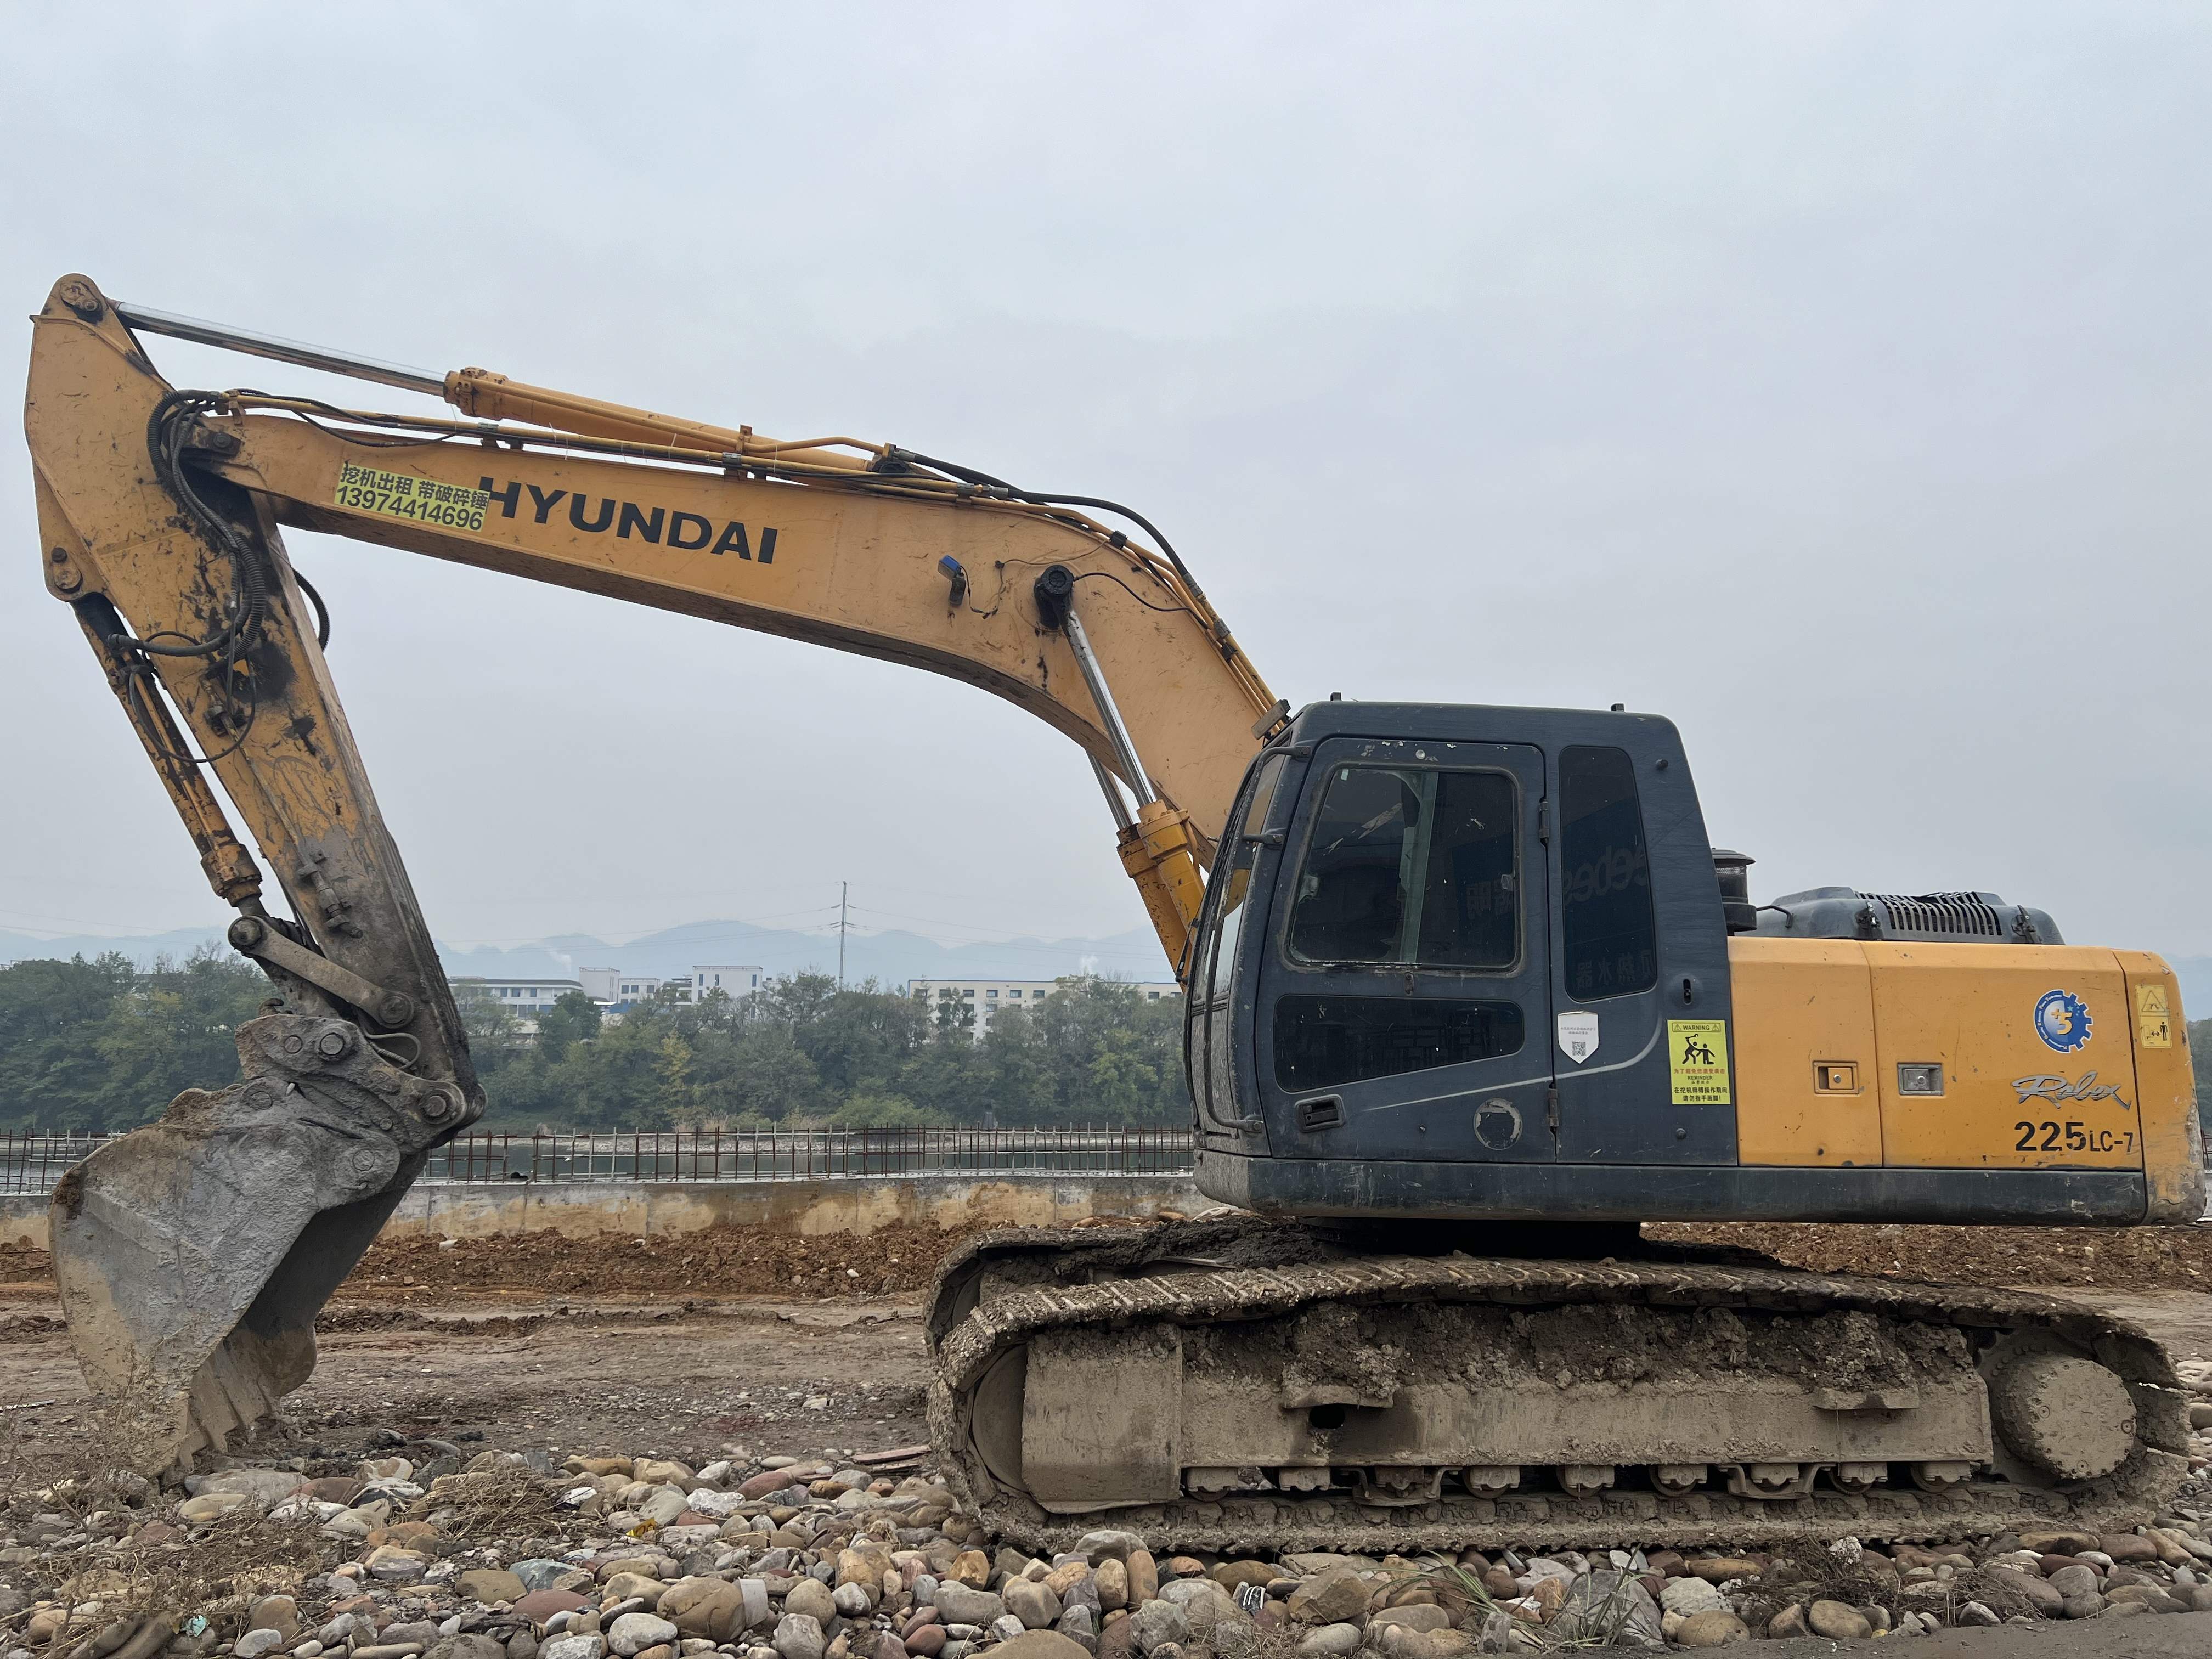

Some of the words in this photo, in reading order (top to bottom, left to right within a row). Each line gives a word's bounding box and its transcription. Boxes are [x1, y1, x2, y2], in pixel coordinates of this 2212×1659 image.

[337, 486, 483, 531] 13974414696
[340, 466, 413, 496] 挖机出租
[418, 480, 489, 510] 带破碎锤
[478, 476, 778, 564] HYUNDAI
